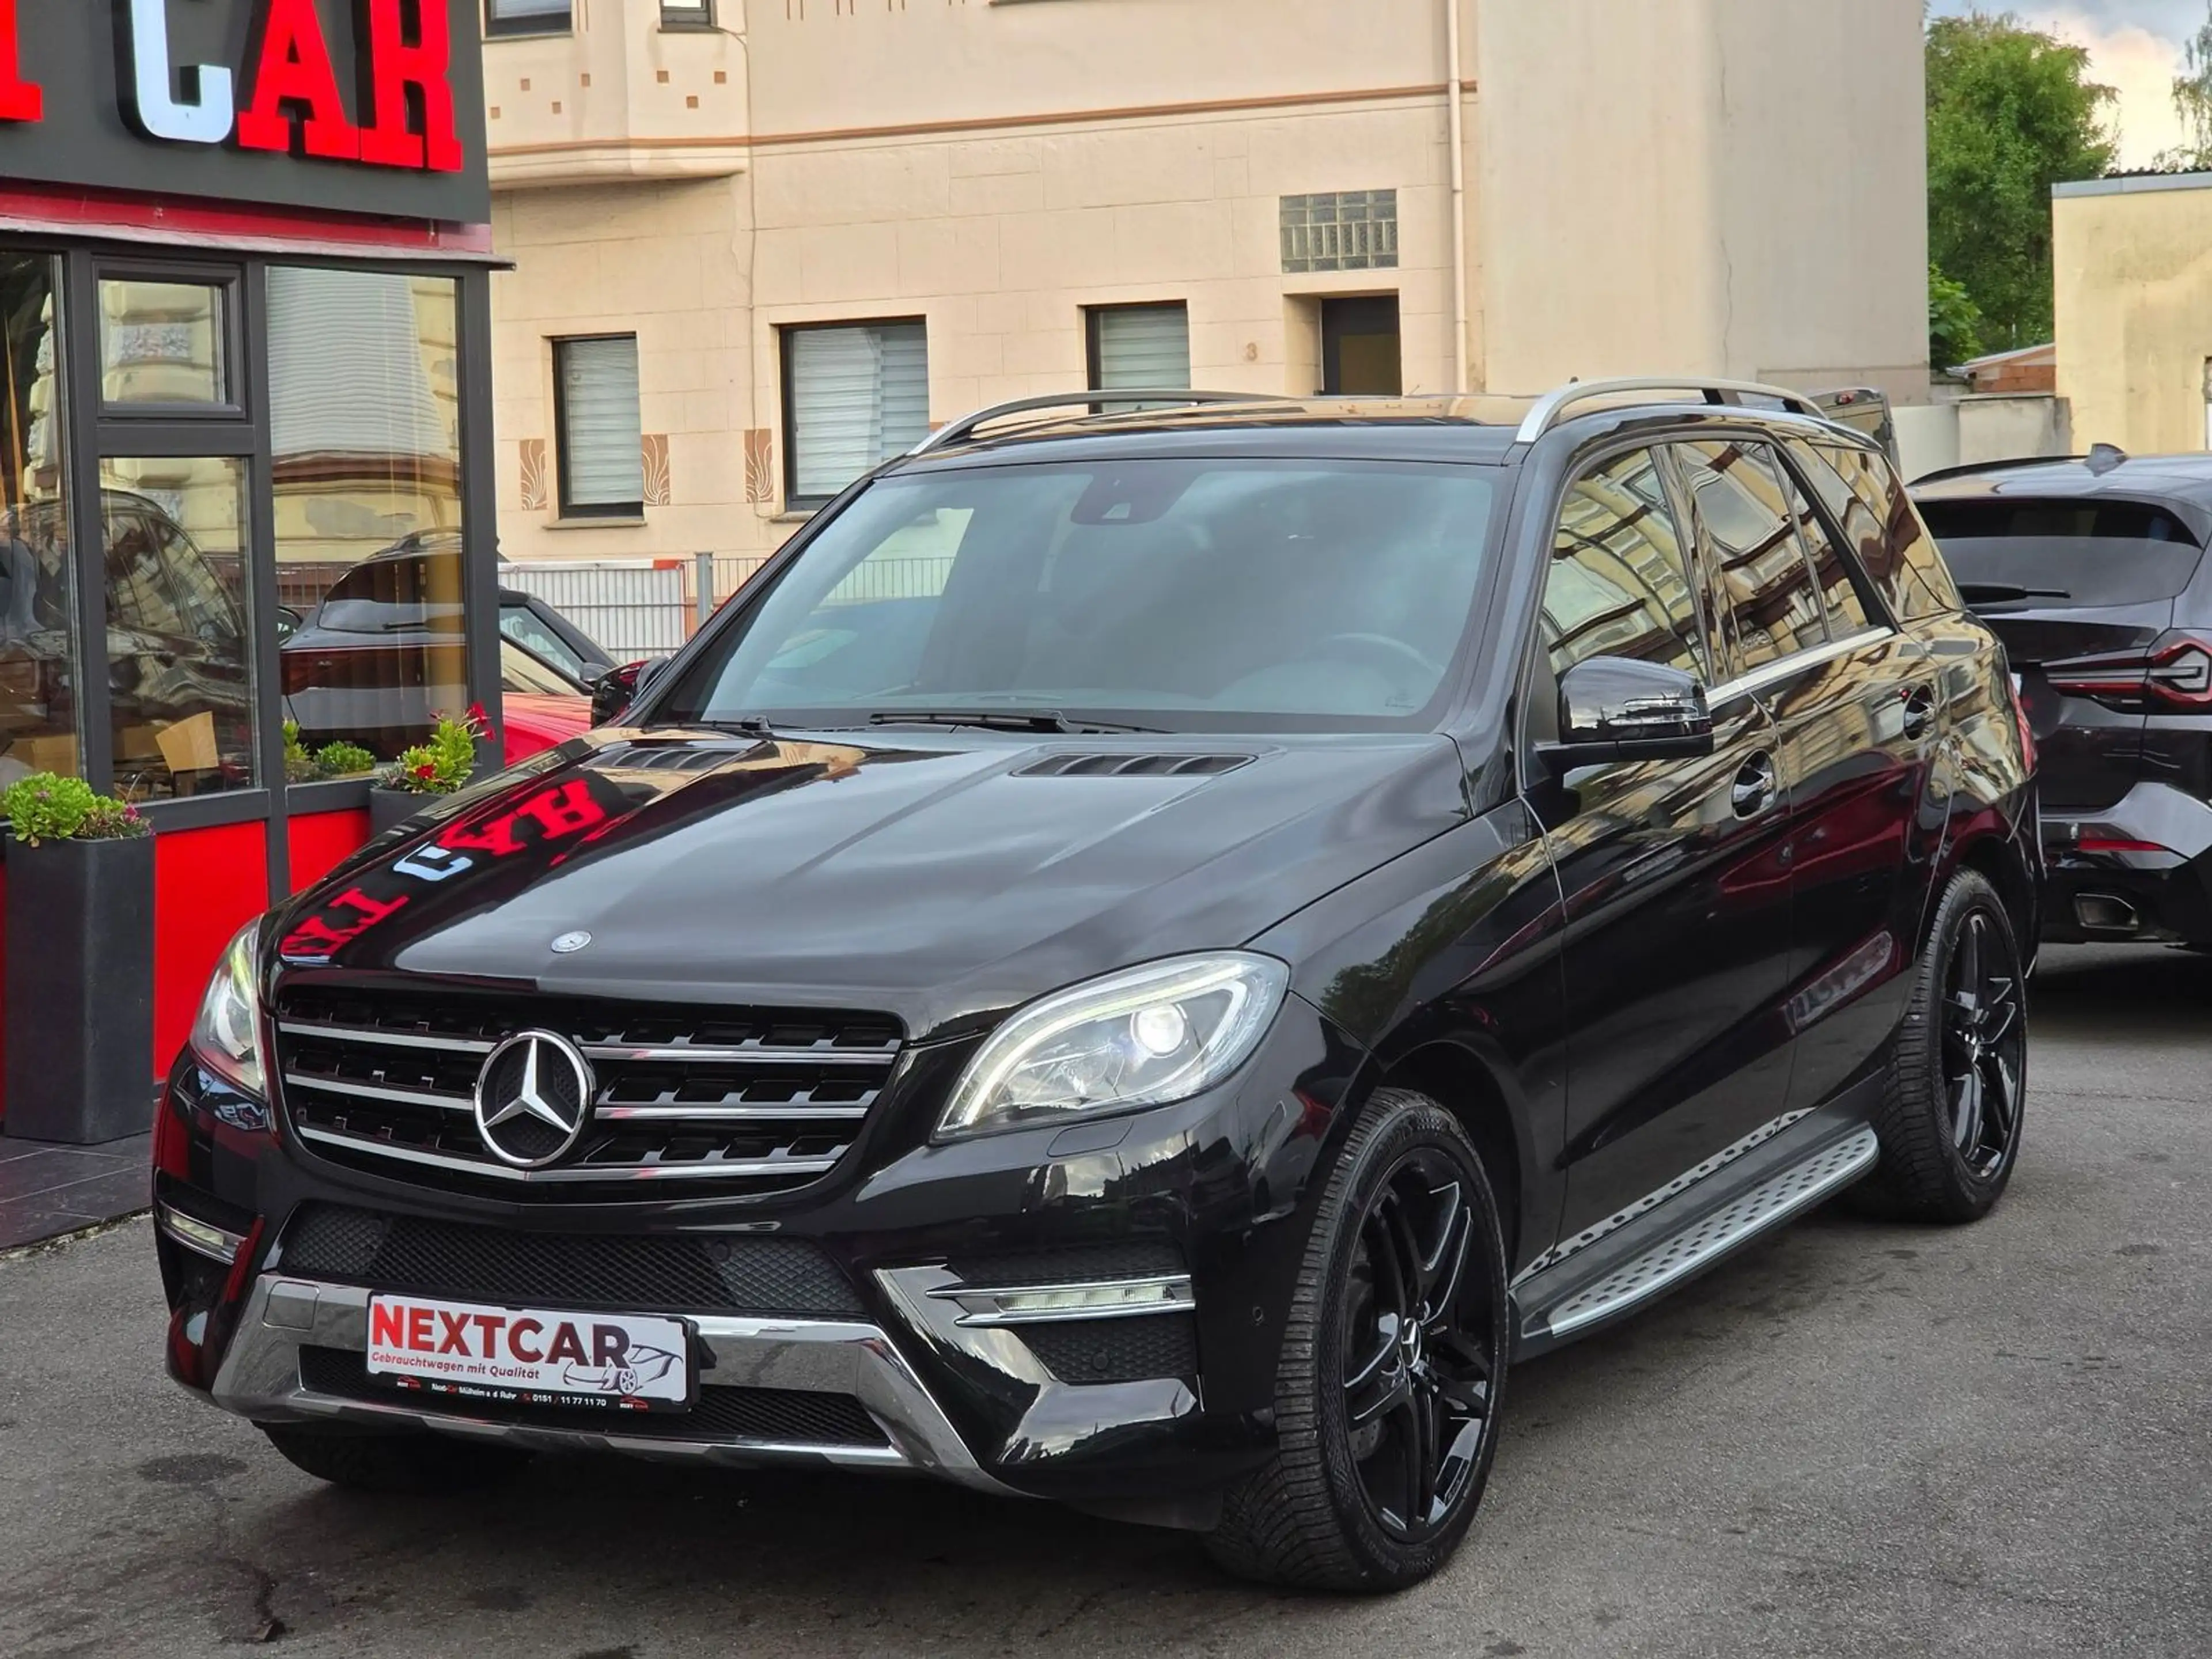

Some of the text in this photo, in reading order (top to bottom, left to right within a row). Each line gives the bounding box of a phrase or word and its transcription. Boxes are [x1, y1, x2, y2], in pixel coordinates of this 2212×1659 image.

[130, 0, 463, 172] CAR
[1246, 342, 1257, 362] 3
[372, 1302, 632, 1369] NEXTCAR
[372, 1351, 539, 1379] Gebrauchtwagen mit Qualität
